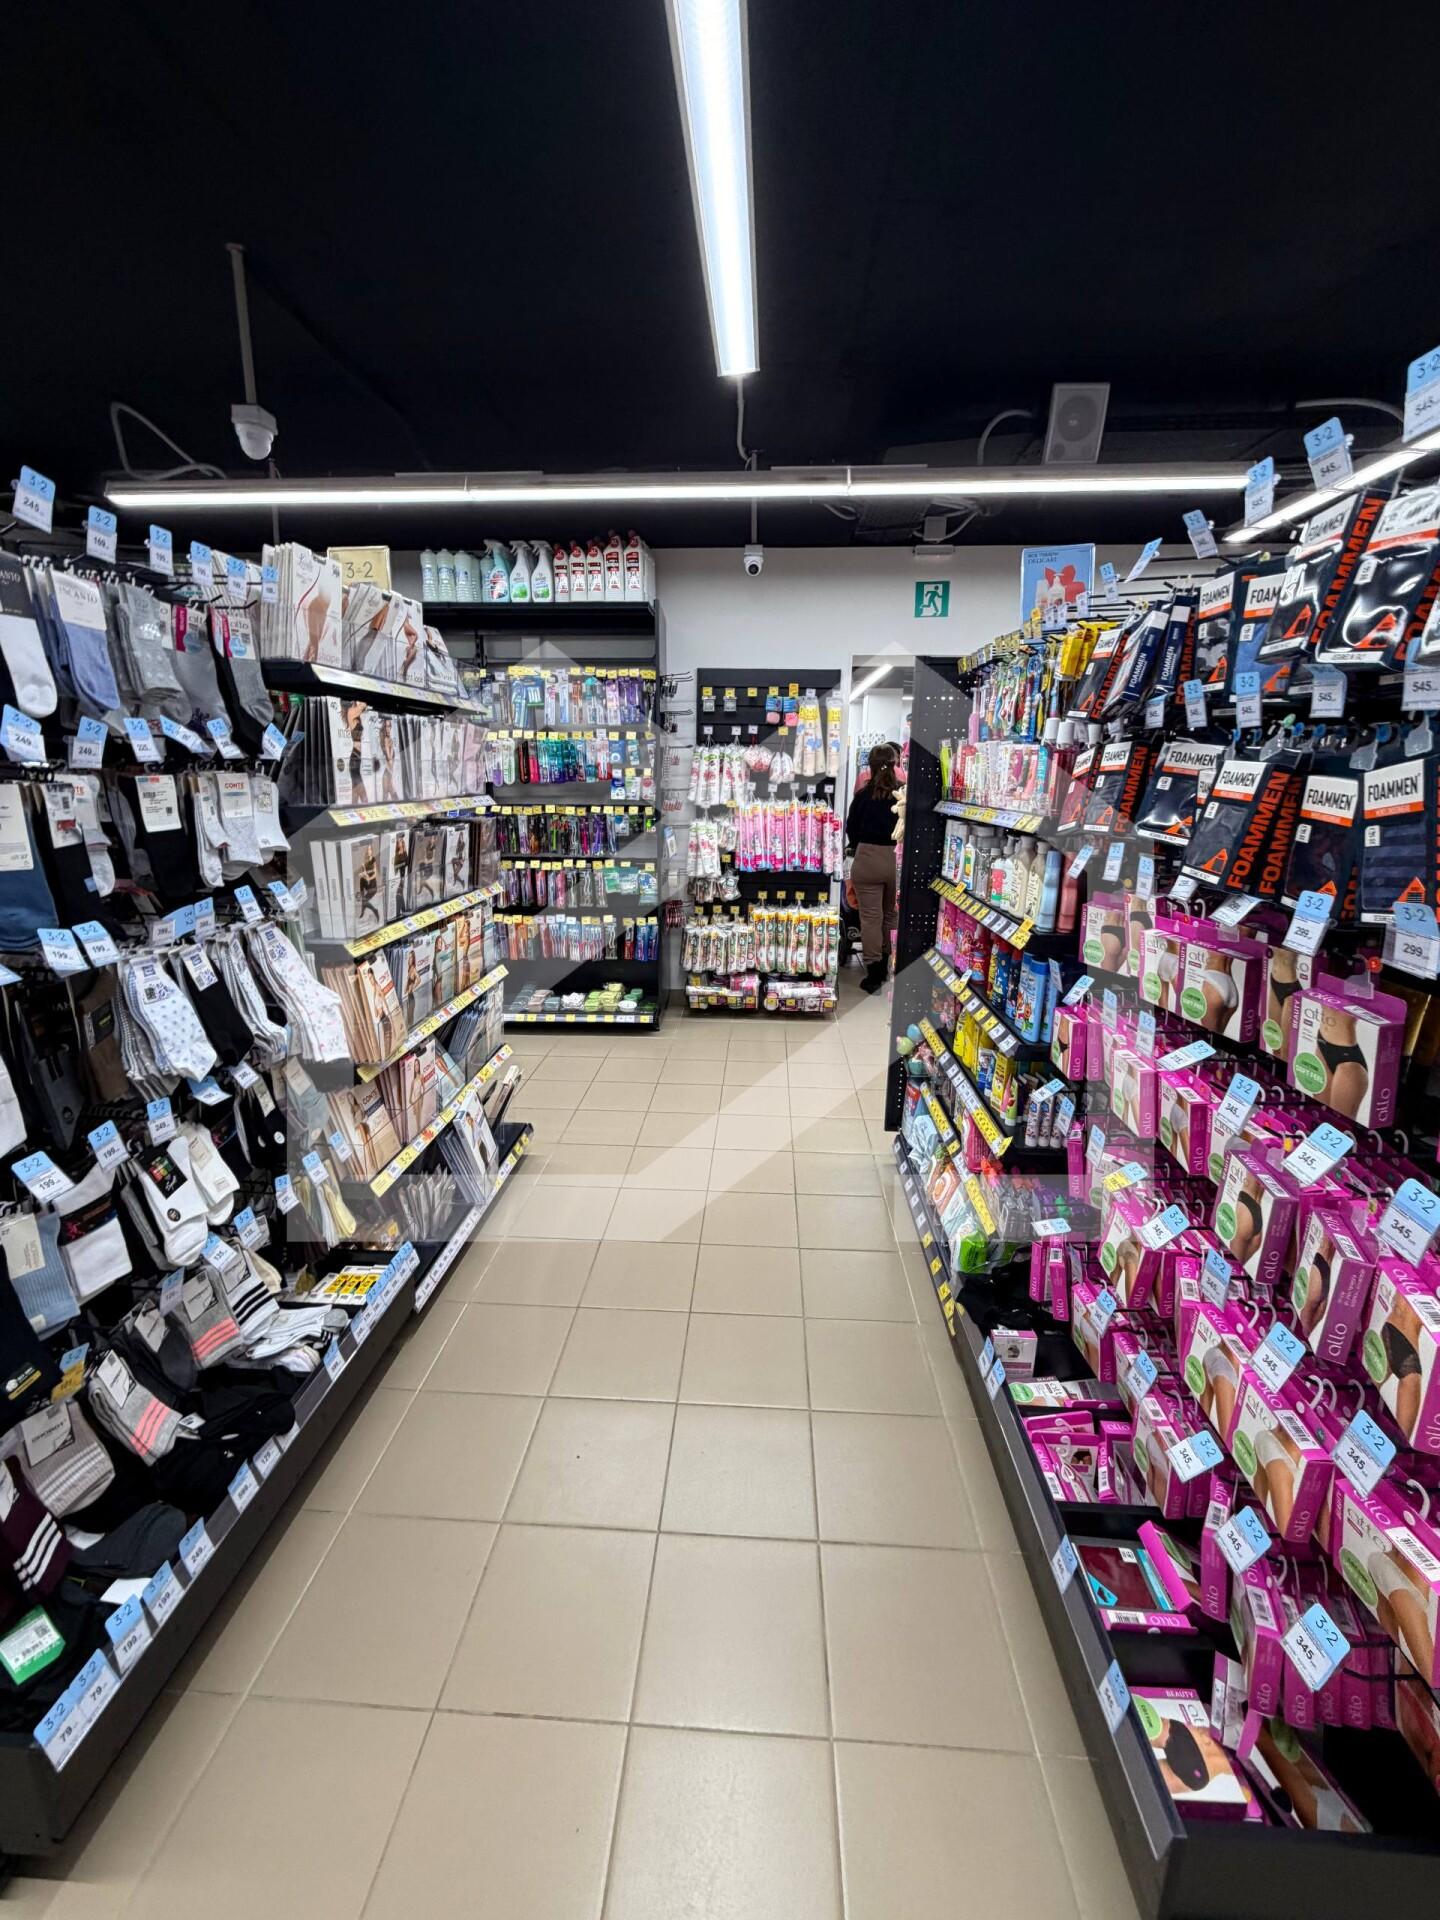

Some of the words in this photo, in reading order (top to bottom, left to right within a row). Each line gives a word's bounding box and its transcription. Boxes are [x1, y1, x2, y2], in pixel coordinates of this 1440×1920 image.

[1129, 652, 1147, 688] FOAMMEN
[1160, 646, 1175, 681] FOAMMEN
[1412, 680, 1432, 693] 545
[1169, 751, 1216, 767] FOAMMEN
[224, 782, 245, 790] CONTE
[1219, 770, 1260, 788] FOAMMEN
[1368, 774, 1419, 802] FOAMMEN
[1114, 746, 1147, 833] FOAMMEN
[1307, 788, 1354, 812] FOAMMEN
[1226, 771, 1290, 889] FOAMMEN
[1402, 943, 1423, 957] 299
[1292, 1000, 1300, 1029] BEAUTY
[1225, 1101, 1238, 1114] 345
[1376, 1088, 1391, 1121] allo
[102, 1147, 116, 1160] 199
[1298, 1151, 1315, 1166] 345
[38, 1177, 55, 1191] 199
[1152, 1224, 1163, 1236] 345
[1390, 1219, 1411, 1239] 345
[1264, 1251, 1280, 1279] allo
[1392, 1268, 1420, 1295] allo
[1207, 1309, 1228, 1332] allo
[1328, 1322, 1347, 1357] allo
[1262, 1354, 1278, 1372] 345
[1257, 1380, 1282, 1408] allo
[1180, 1447, 1192, 1464] 345
[1347, 1447, 1366, 1470] 345
[1227, 1530, 1242, 1551] 345
[1207, 1585, 1218, 1613] allo
[122, 1635, 137, 1653] 199
[1295, 1635, 1314, 1660] 345
[90, 1685, 103, 1701] 79
[1165, 1690, 1194, 1699] BEAUTY
[59, 1727, 72, 1742] 79
